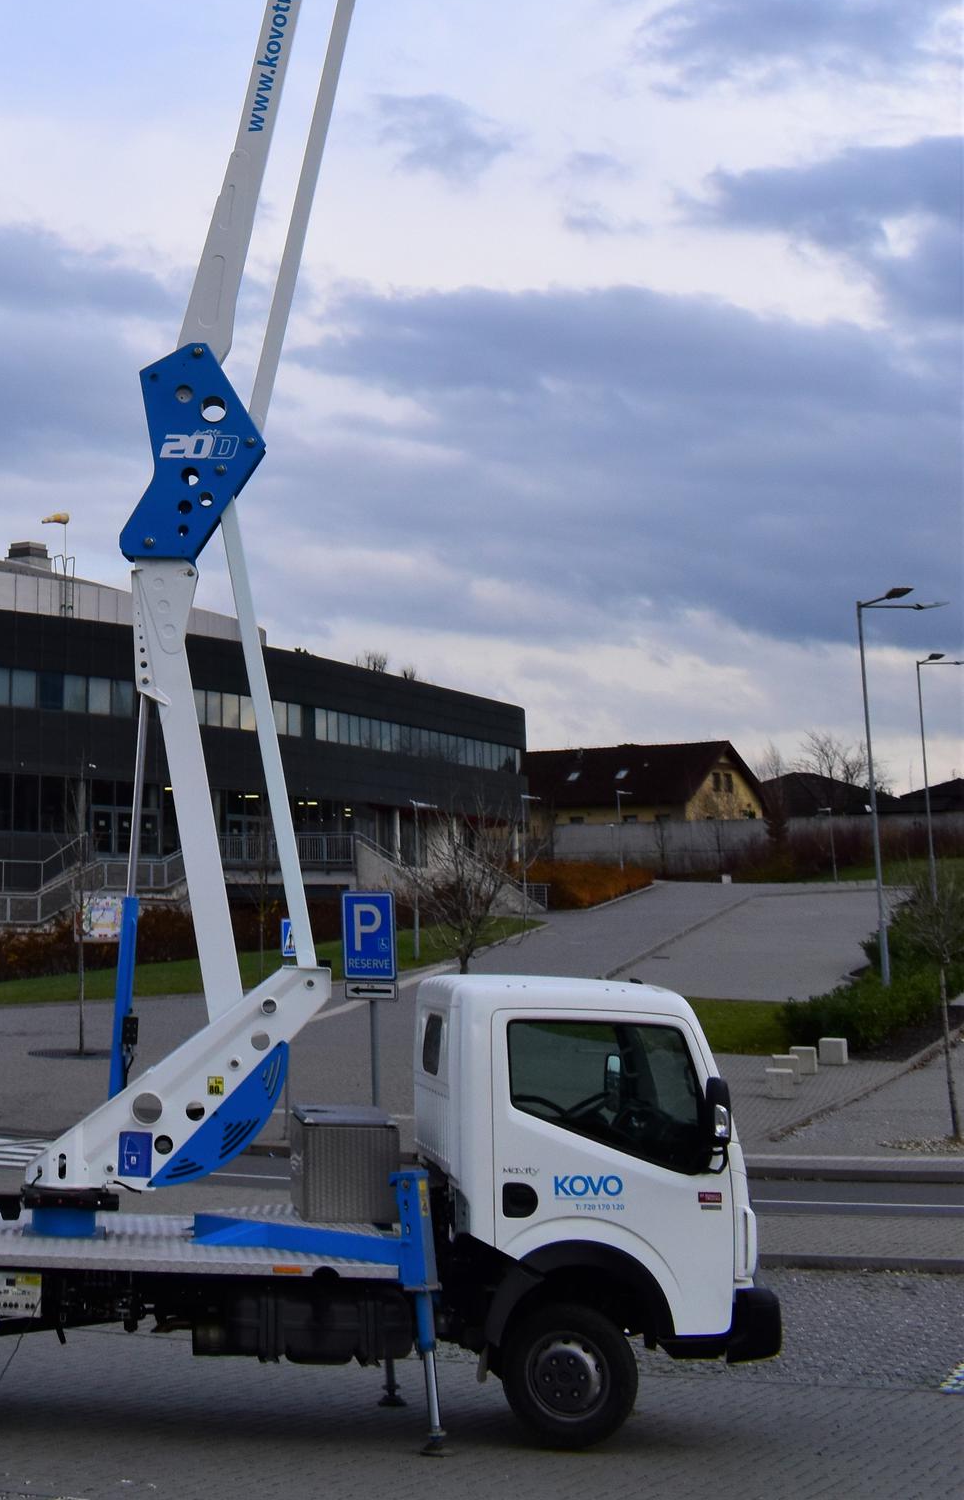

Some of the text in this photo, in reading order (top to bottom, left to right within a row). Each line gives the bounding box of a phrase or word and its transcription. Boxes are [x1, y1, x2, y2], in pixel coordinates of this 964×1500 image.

[159, 434, 240, 460] 20D
[353, 903, 382, 952] P
[553, 1175, 624, 1197] KOVO
